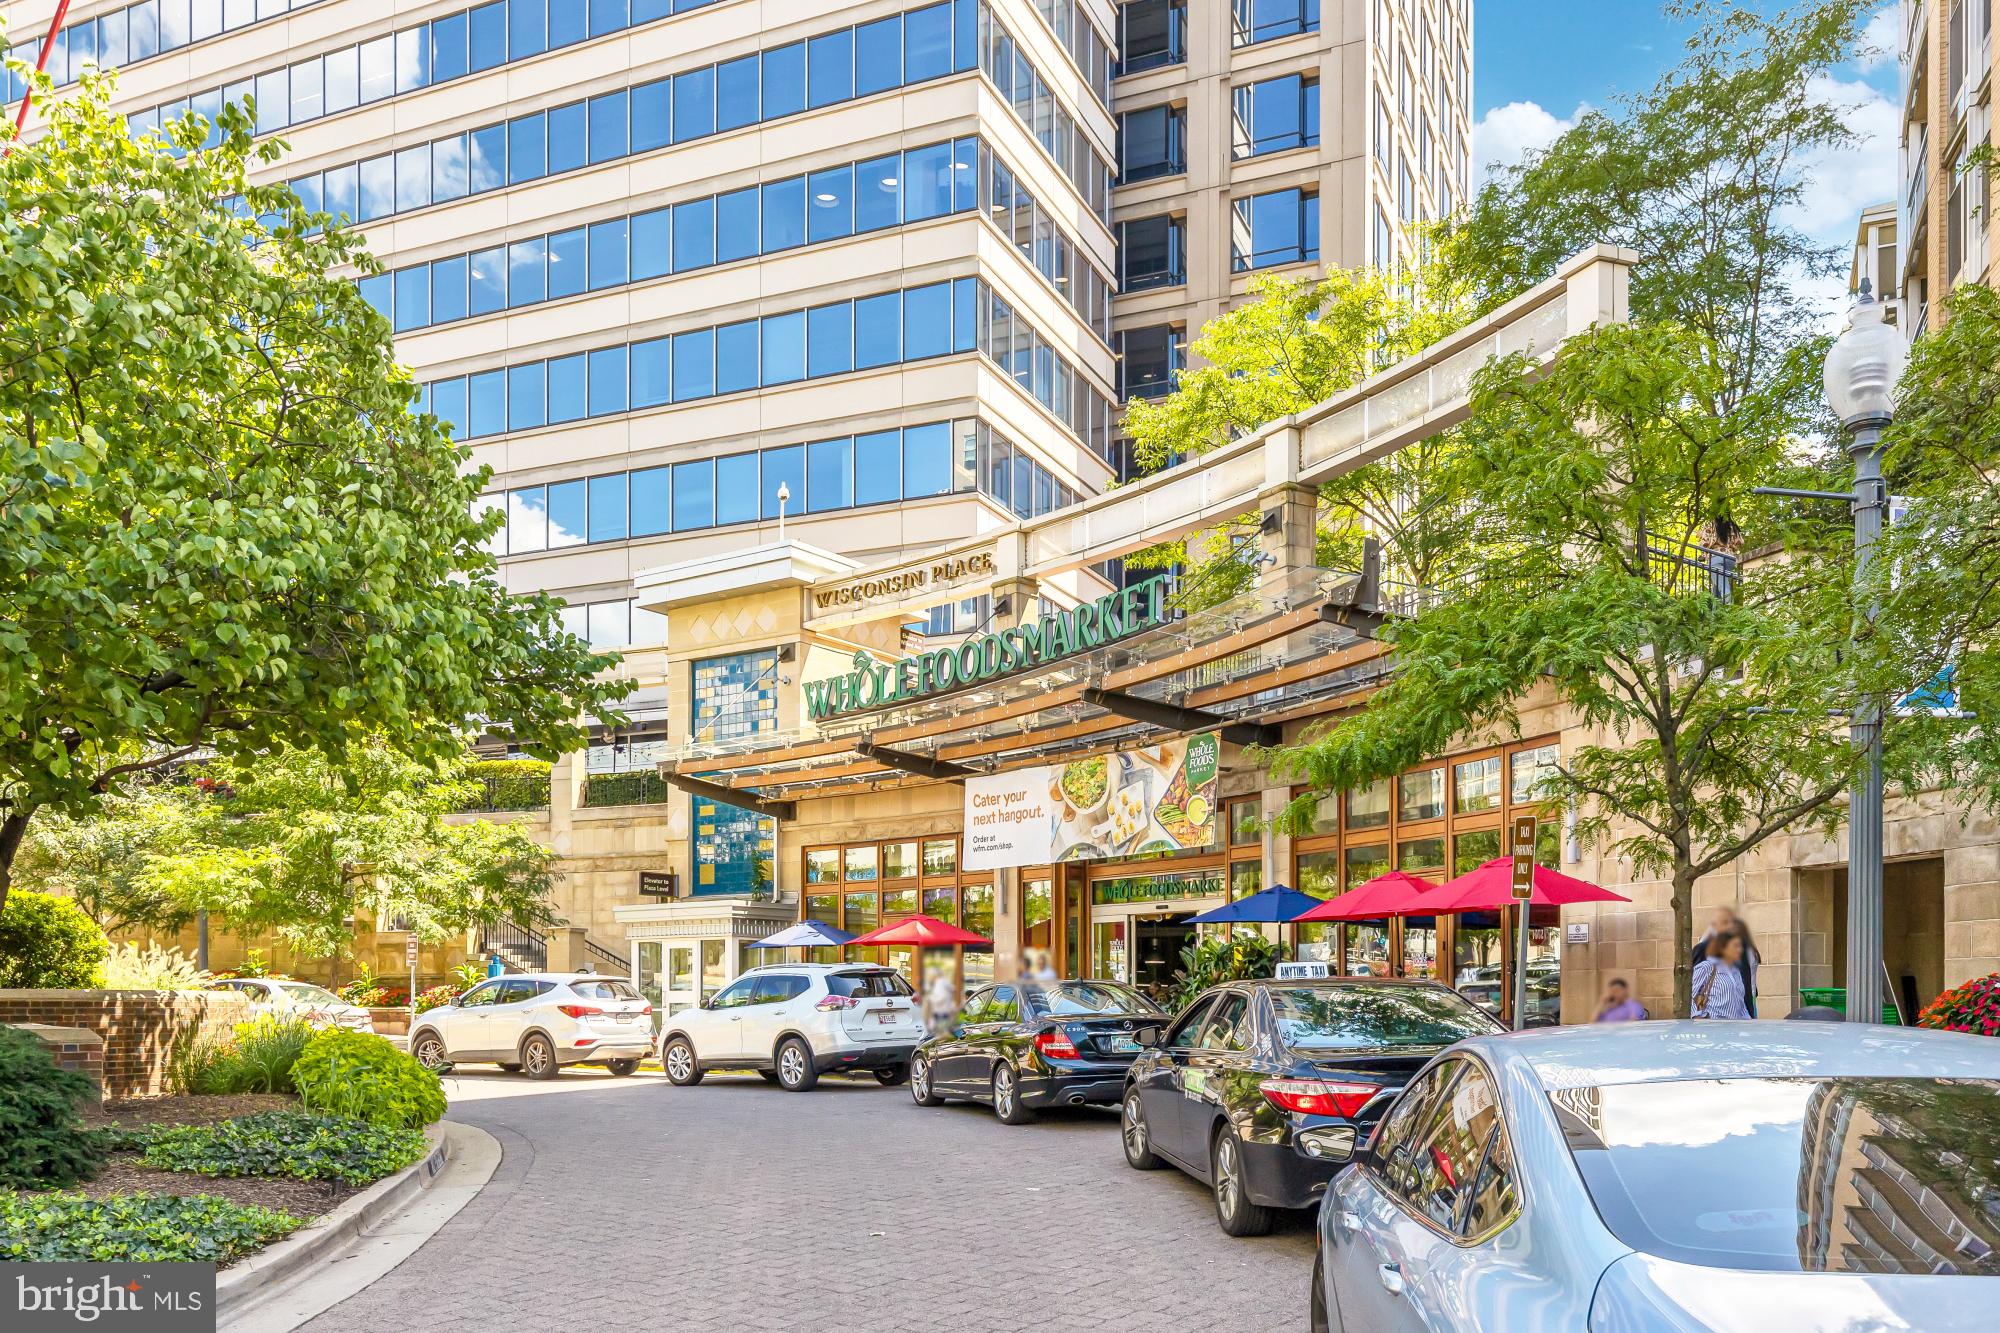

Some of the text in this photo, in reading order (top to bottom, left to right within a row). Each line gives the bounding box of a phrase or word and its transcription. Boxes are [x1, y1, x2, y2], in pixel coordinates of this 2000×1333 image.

[816, 552, 993, 609] WISCONSIN PLACE
[1189, 741, 1214, 758] WHOLE
[1189, 754, 1214, 768] FOODS
[973, 790, 1027, 807] Cater your
[973, 805, 1044, 826] next hangout.
[972, 834, 996, 843] Order at
[1515, 844, 1534, 856] PARKING
[1517, 862, 1529, 874] ONLY
[1280, 965, 1326, 977] ANYTIME TAXI
